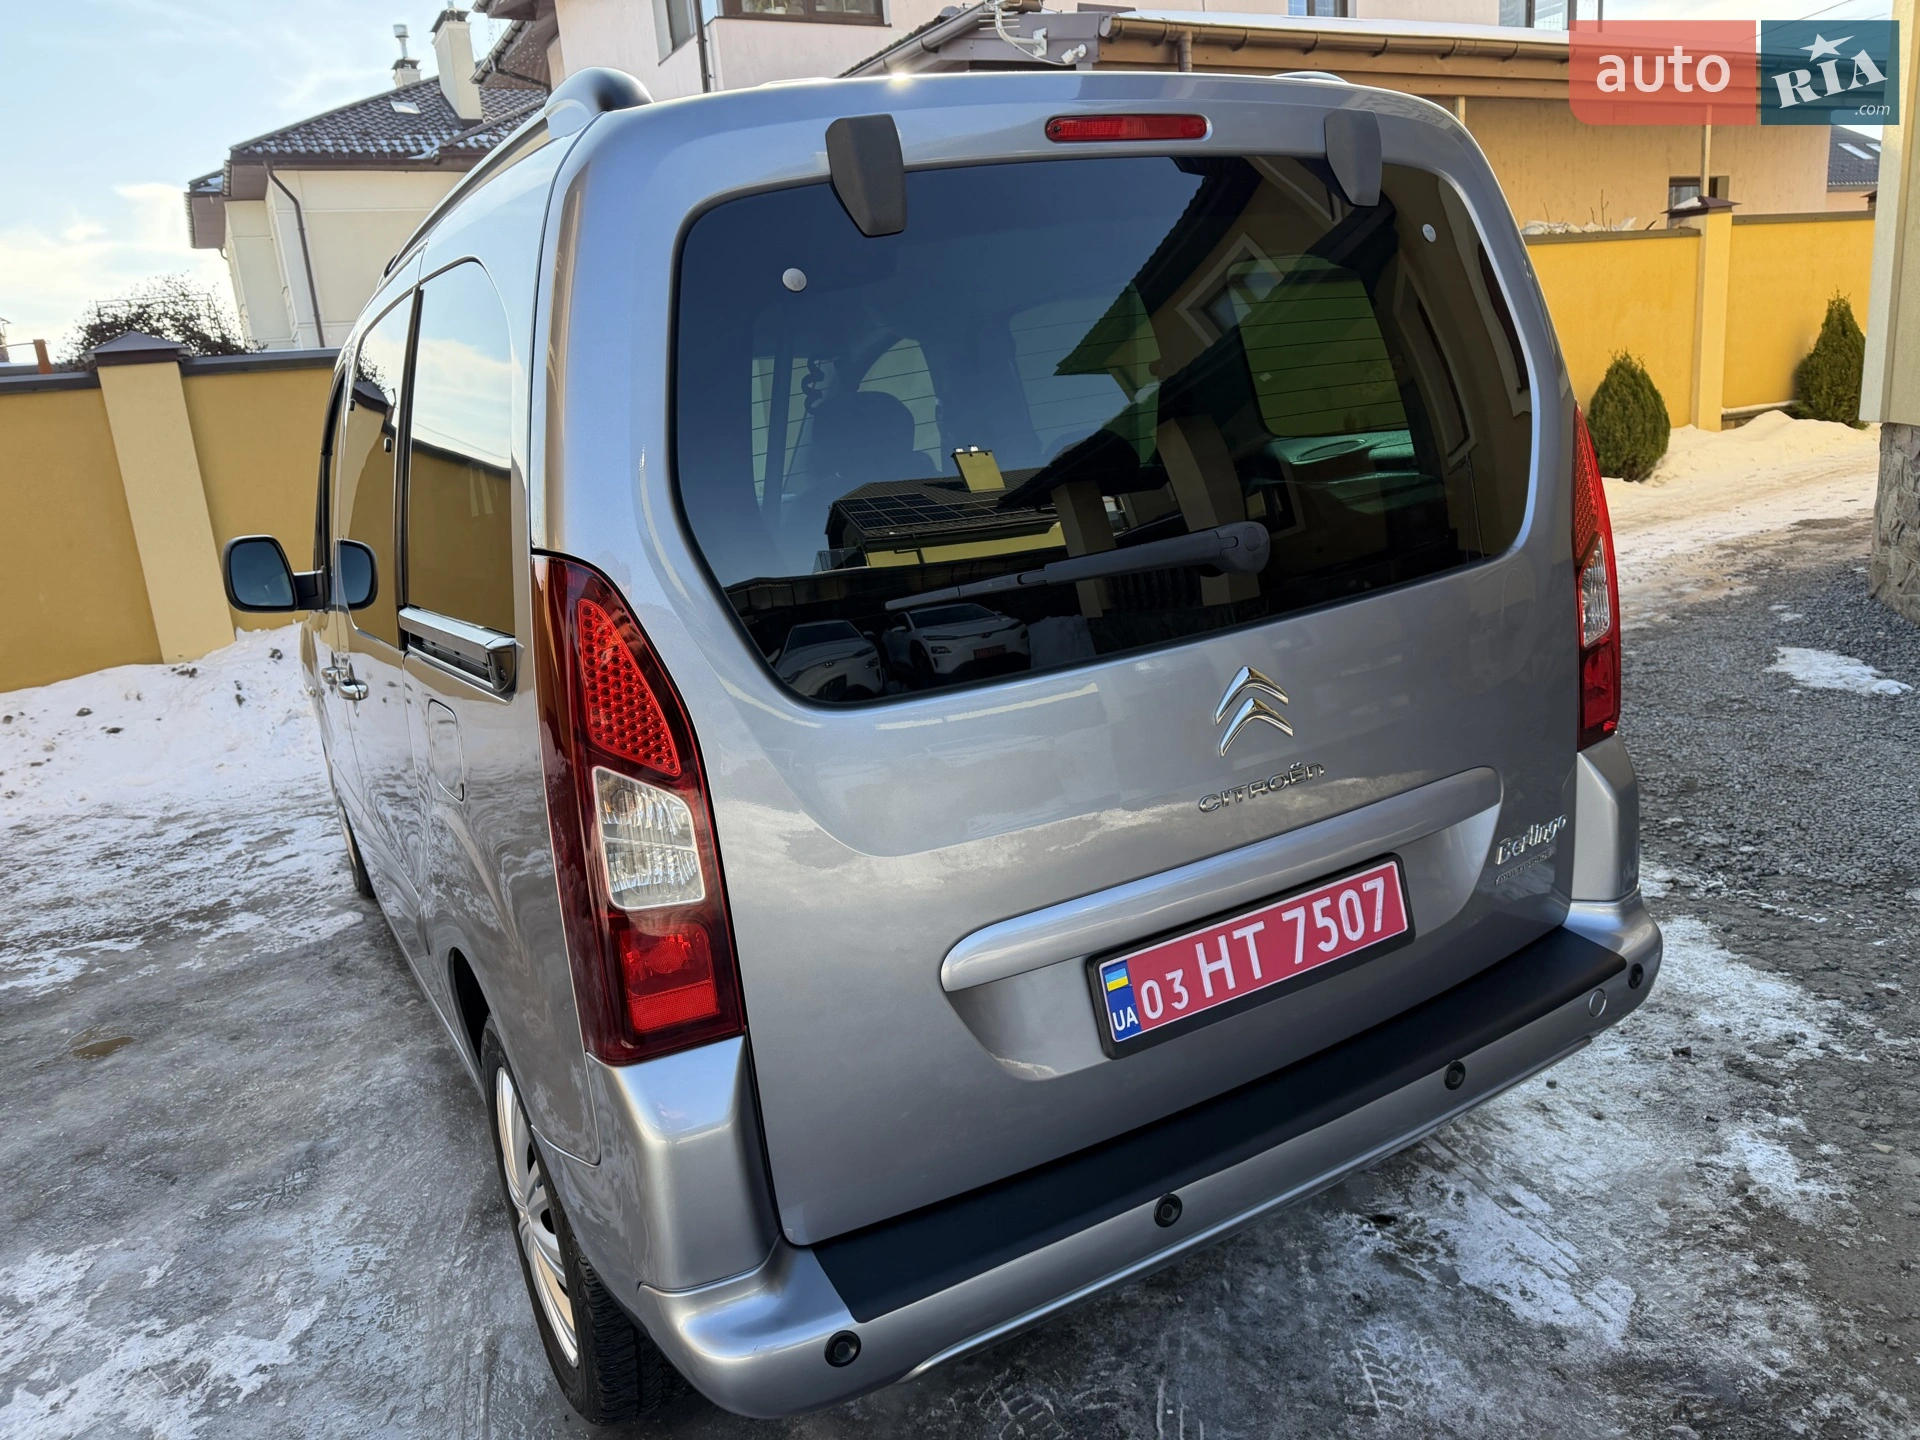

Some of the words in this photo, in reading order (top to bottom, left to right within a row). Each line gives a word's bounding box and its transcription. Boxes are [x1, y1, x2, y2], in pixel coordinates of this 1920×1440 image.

[1198, 762, 1325, 813] CITROËN
[1494, 814, 1567, 865] Berlingo
[1140, 968, 1189, 1020] 03
[1195, 921, 1264, 999] HT
[1281, 876, 1385, 965] 7507
[1112, 1006, 1139, 1031] UA
